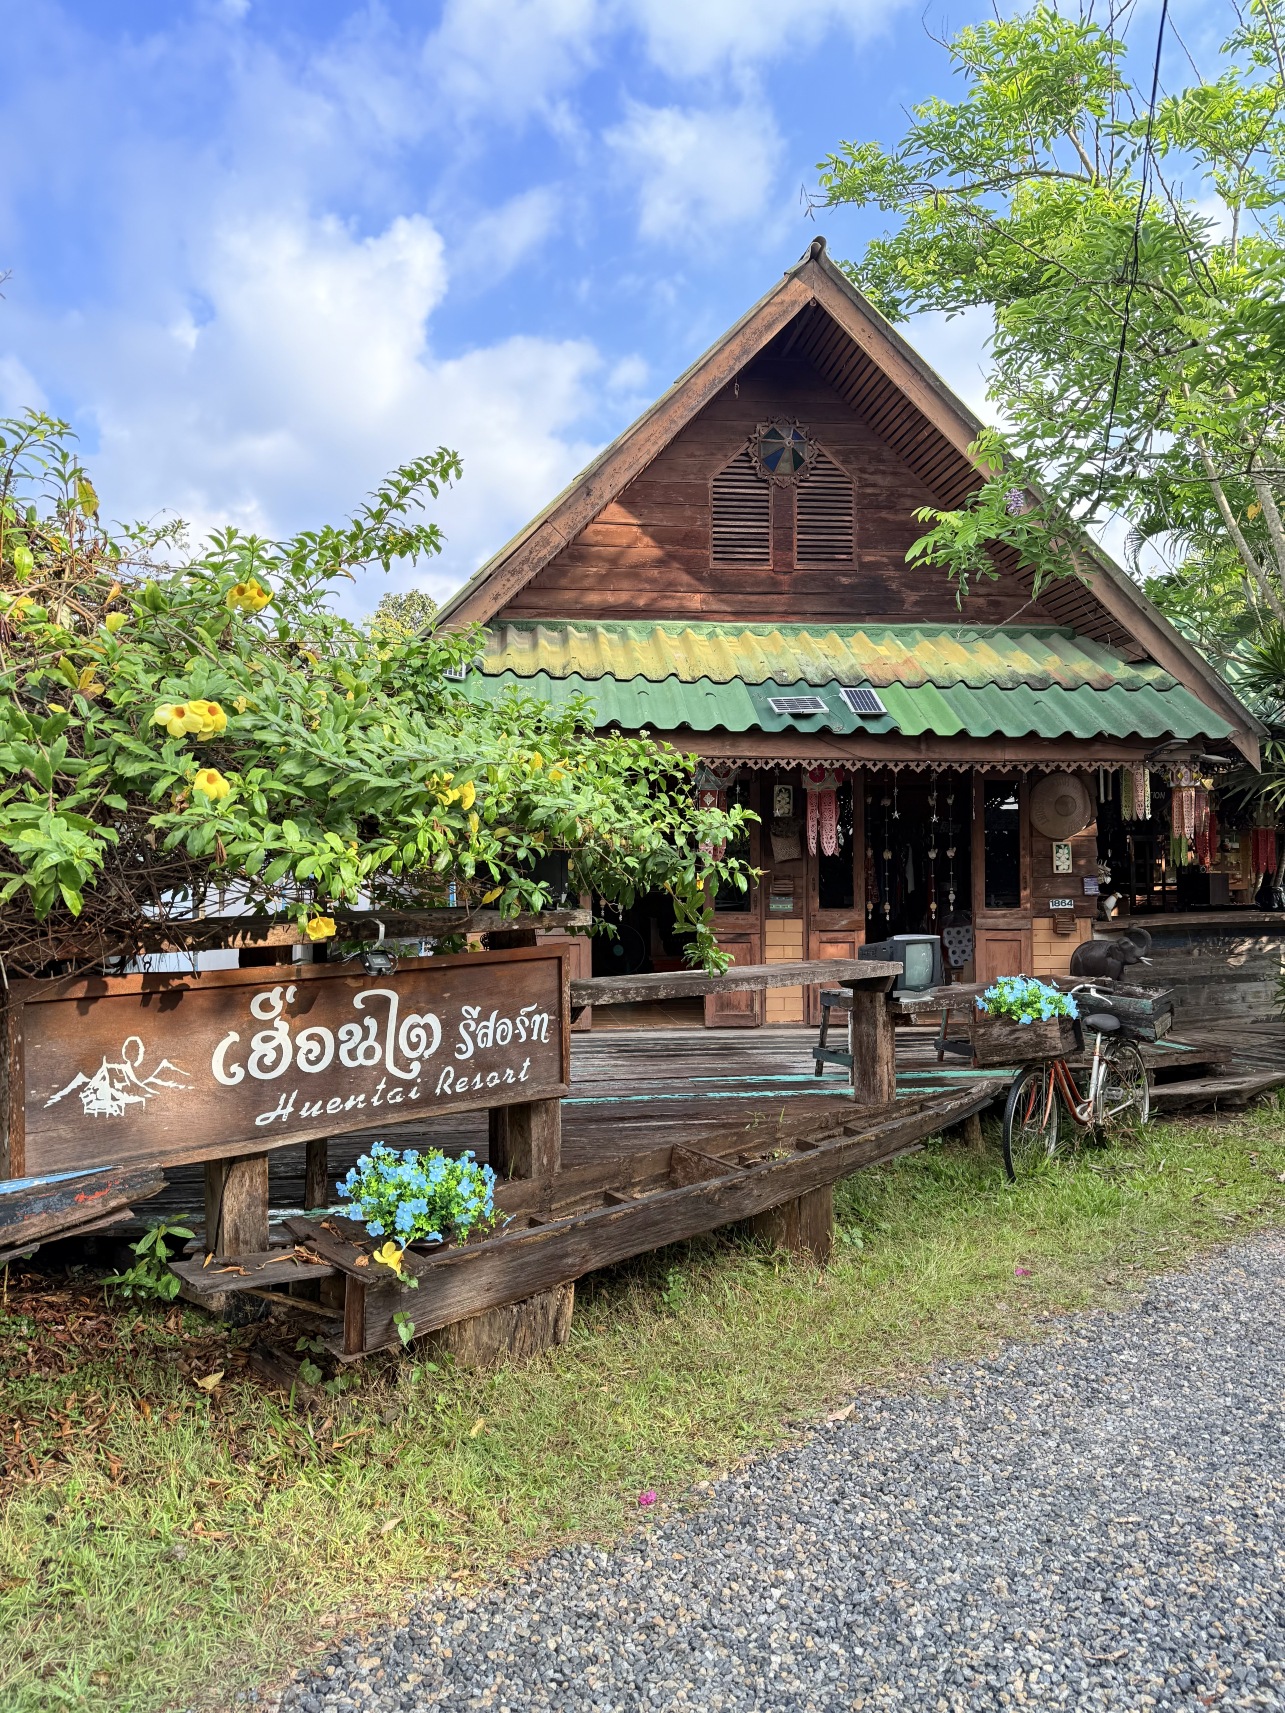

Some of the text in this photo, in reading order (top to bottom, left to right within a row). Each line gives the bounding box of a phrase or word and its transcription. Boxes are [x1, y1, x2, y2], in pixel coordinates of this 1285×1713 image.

[1050, 899, 1073, 908] 1864
[211, 985, 550, 1086] เฮือนไต รีสอร์ท
[255, 1057, 531, 1126] Huentai Resort
